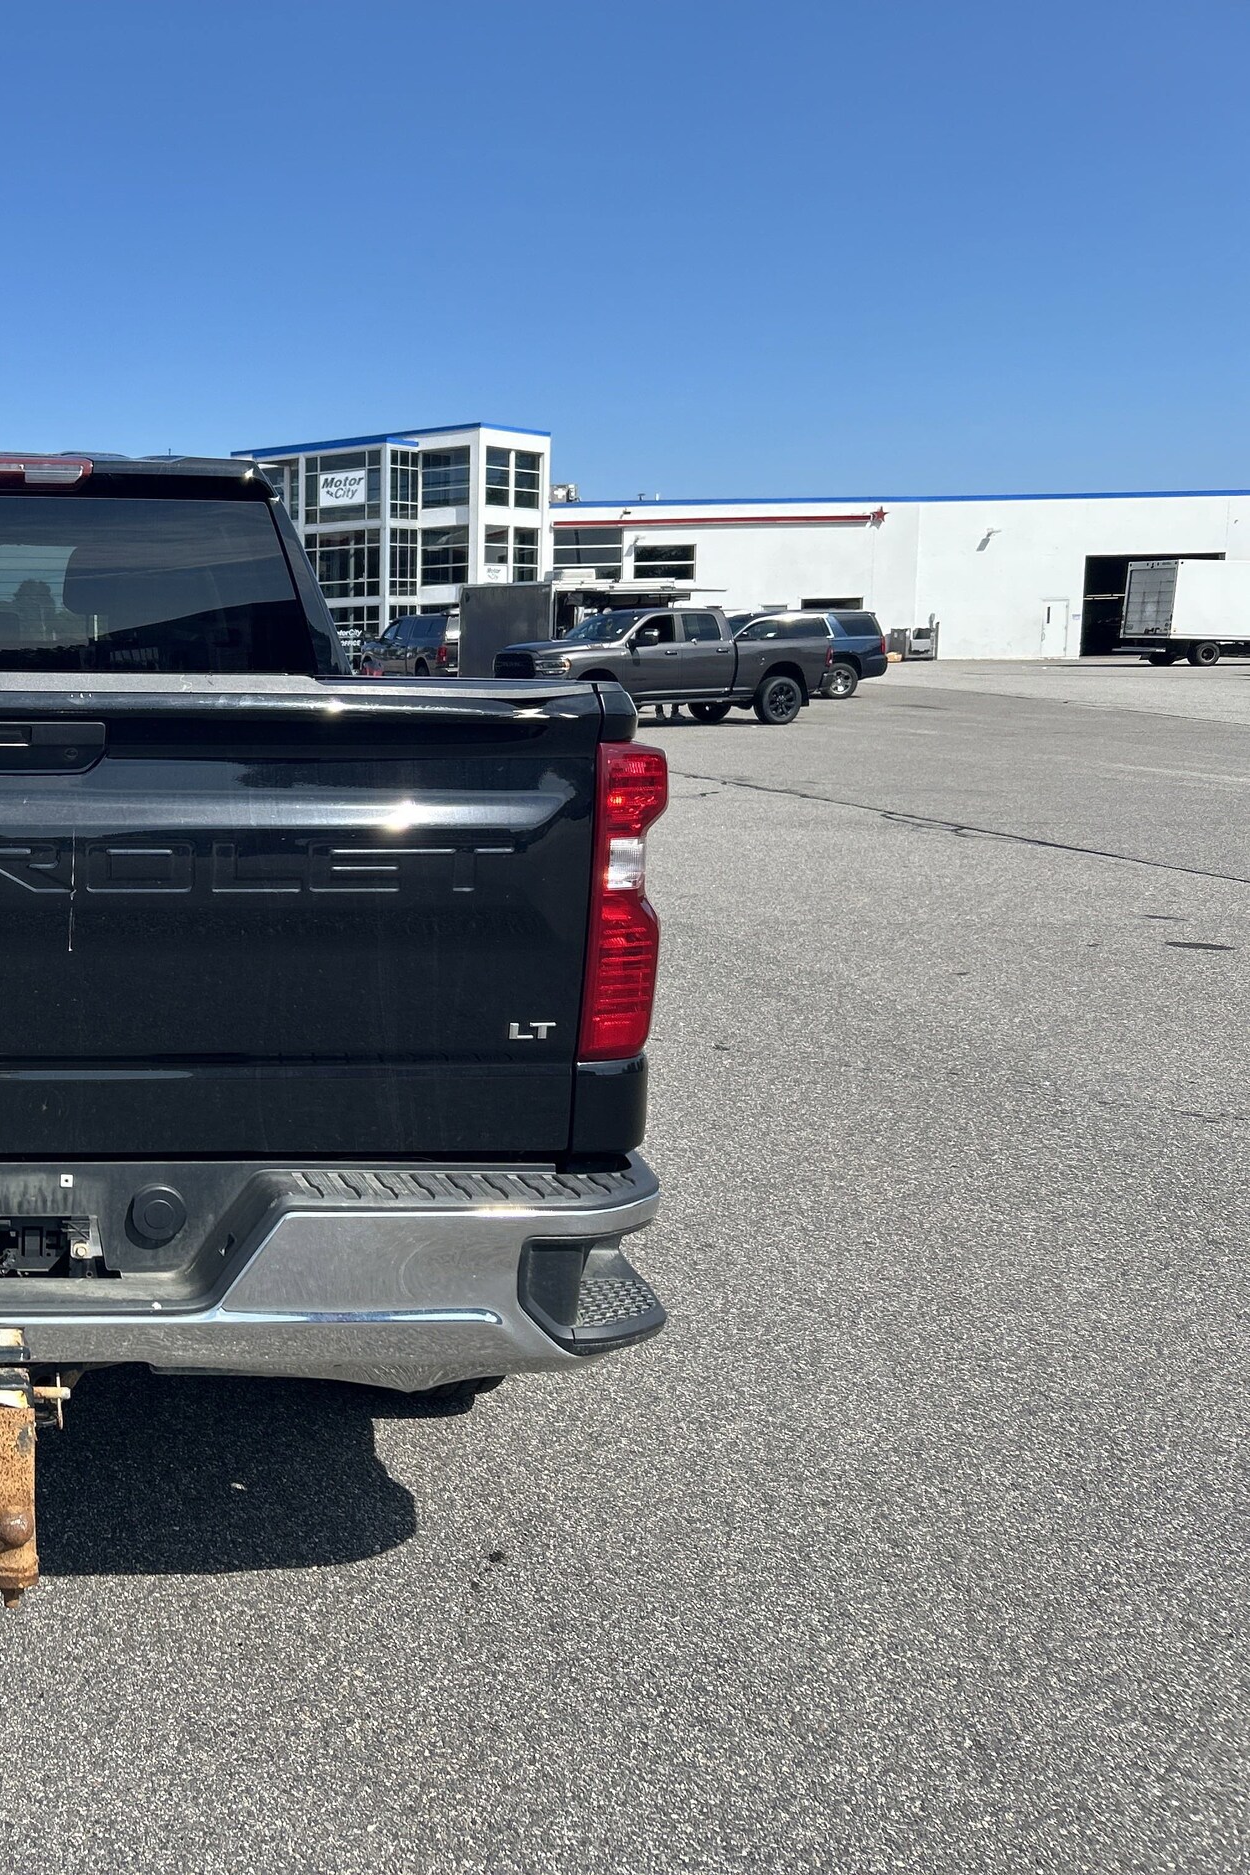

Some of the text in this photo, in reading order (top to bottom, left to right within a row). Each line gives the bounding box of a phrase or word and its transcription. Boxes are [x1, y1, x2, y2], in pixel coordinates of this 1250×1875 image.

[321, 476, 364, 489] Motor
[334, 487, 358, 500] City
[508, 1021, 557, 1040] LT
